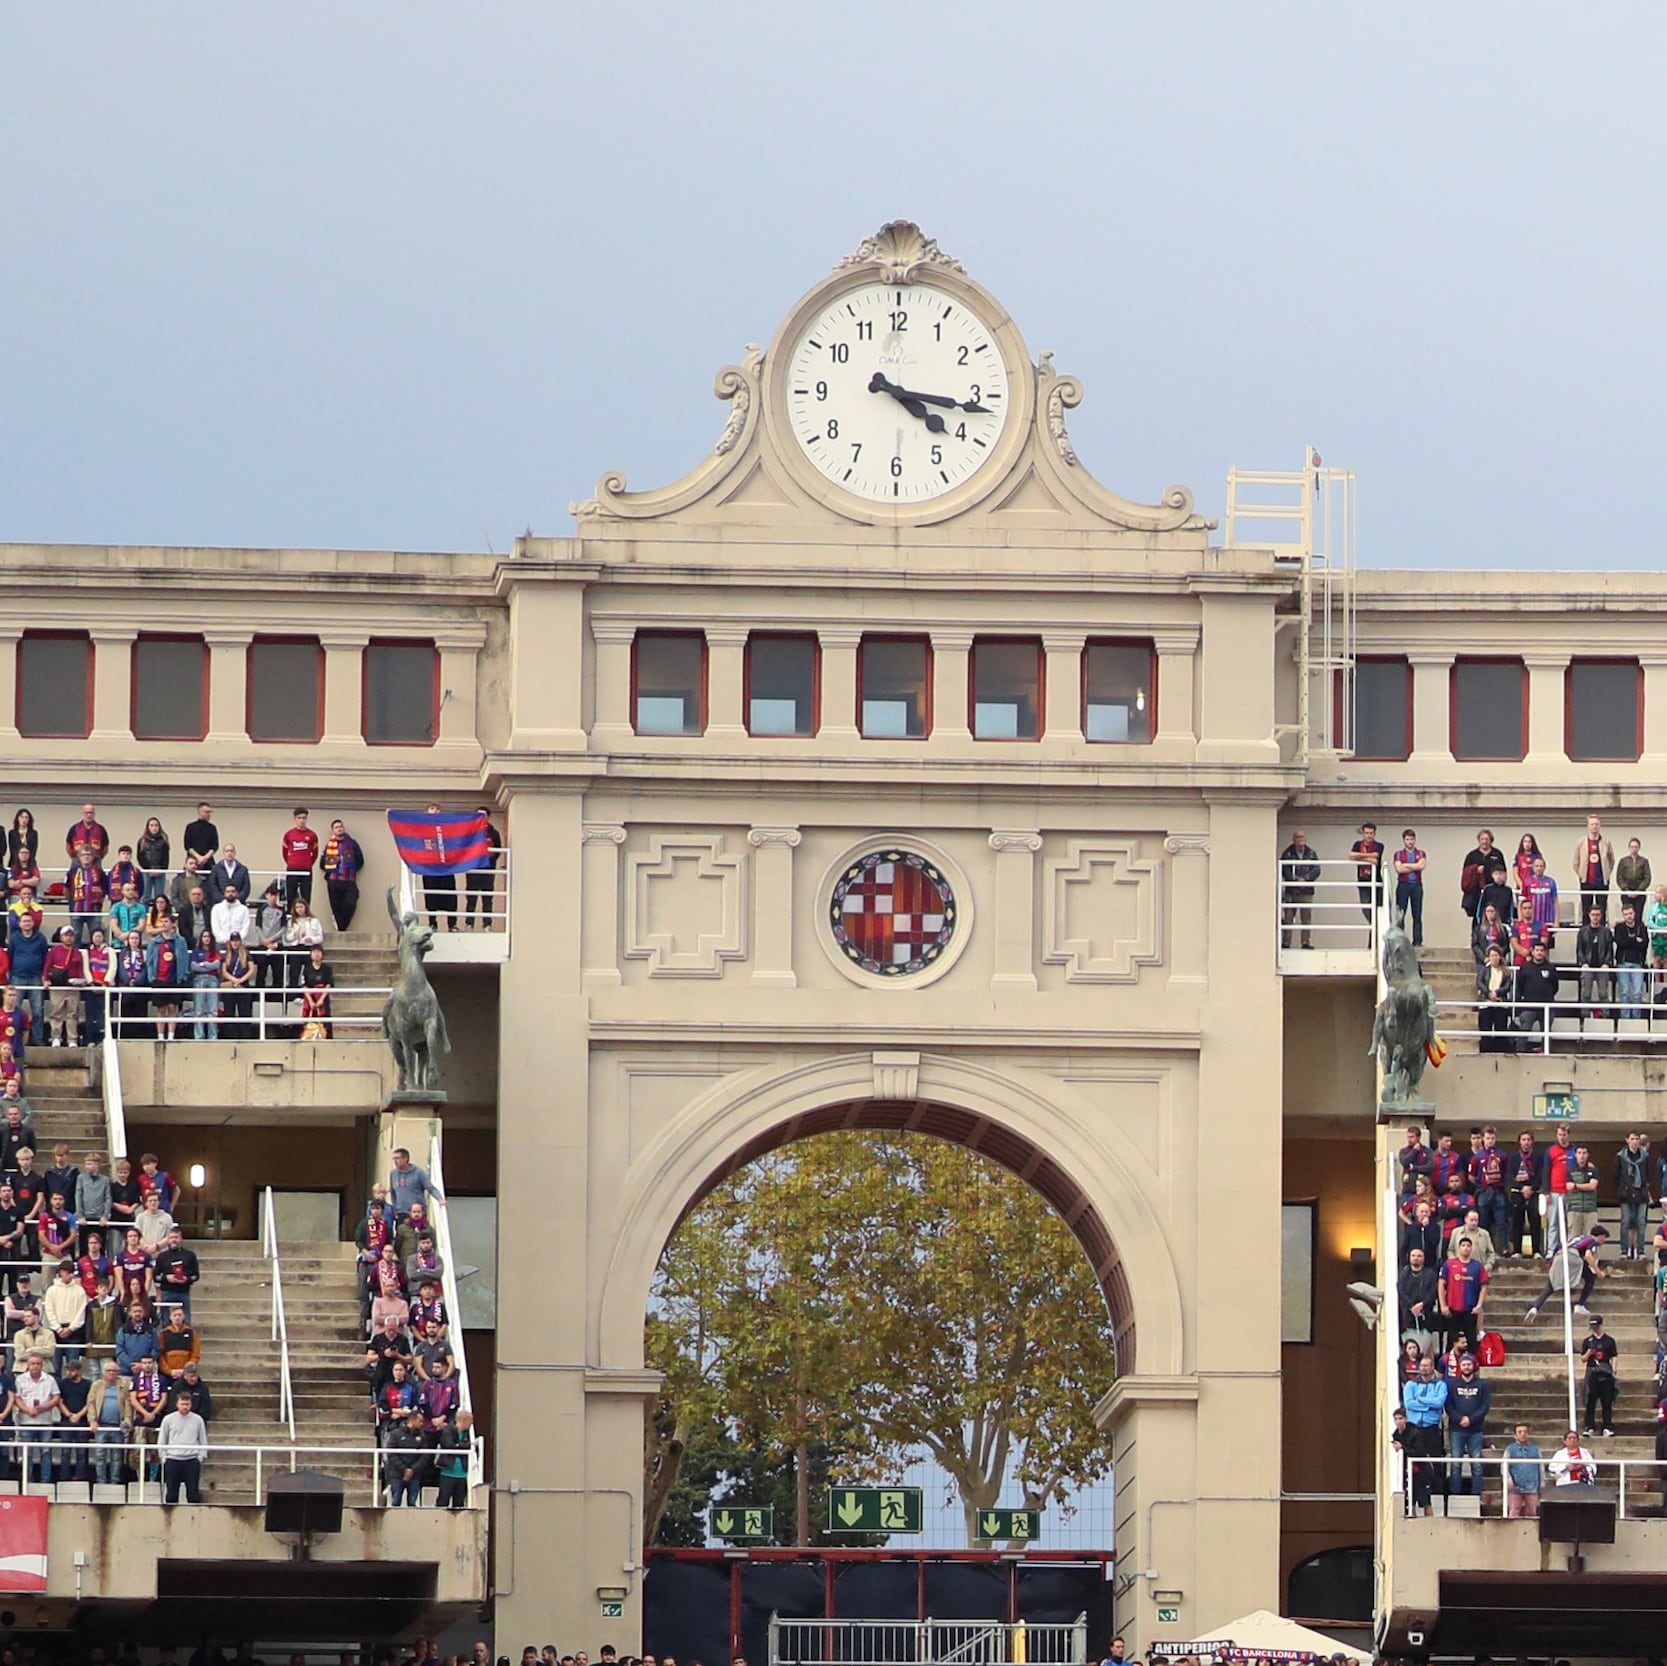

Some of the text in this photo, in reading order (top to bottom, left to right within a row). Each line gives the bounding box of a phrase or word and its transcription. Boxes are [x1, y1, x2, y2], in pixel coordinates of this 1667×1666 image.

[856, 321, 872, 340] 11
[888, 312, 908, 331] 12
[933, 323, 941, 341] 1
[829, 343, 849, 363] 10
[957, 346, 969, 365] 2
[816, 381, 828, 401] 9
[969, 384, 981, 404] 3
[827, 419, 839, 439] 8
[955, 422, 967, 442] 4
[851, 443, 863, 463] 7
[930, 445, 942, 464] 5
[891, 457, 902, 477] 6
[1229, 1648, 1297, 1660] FC BARCELONA
